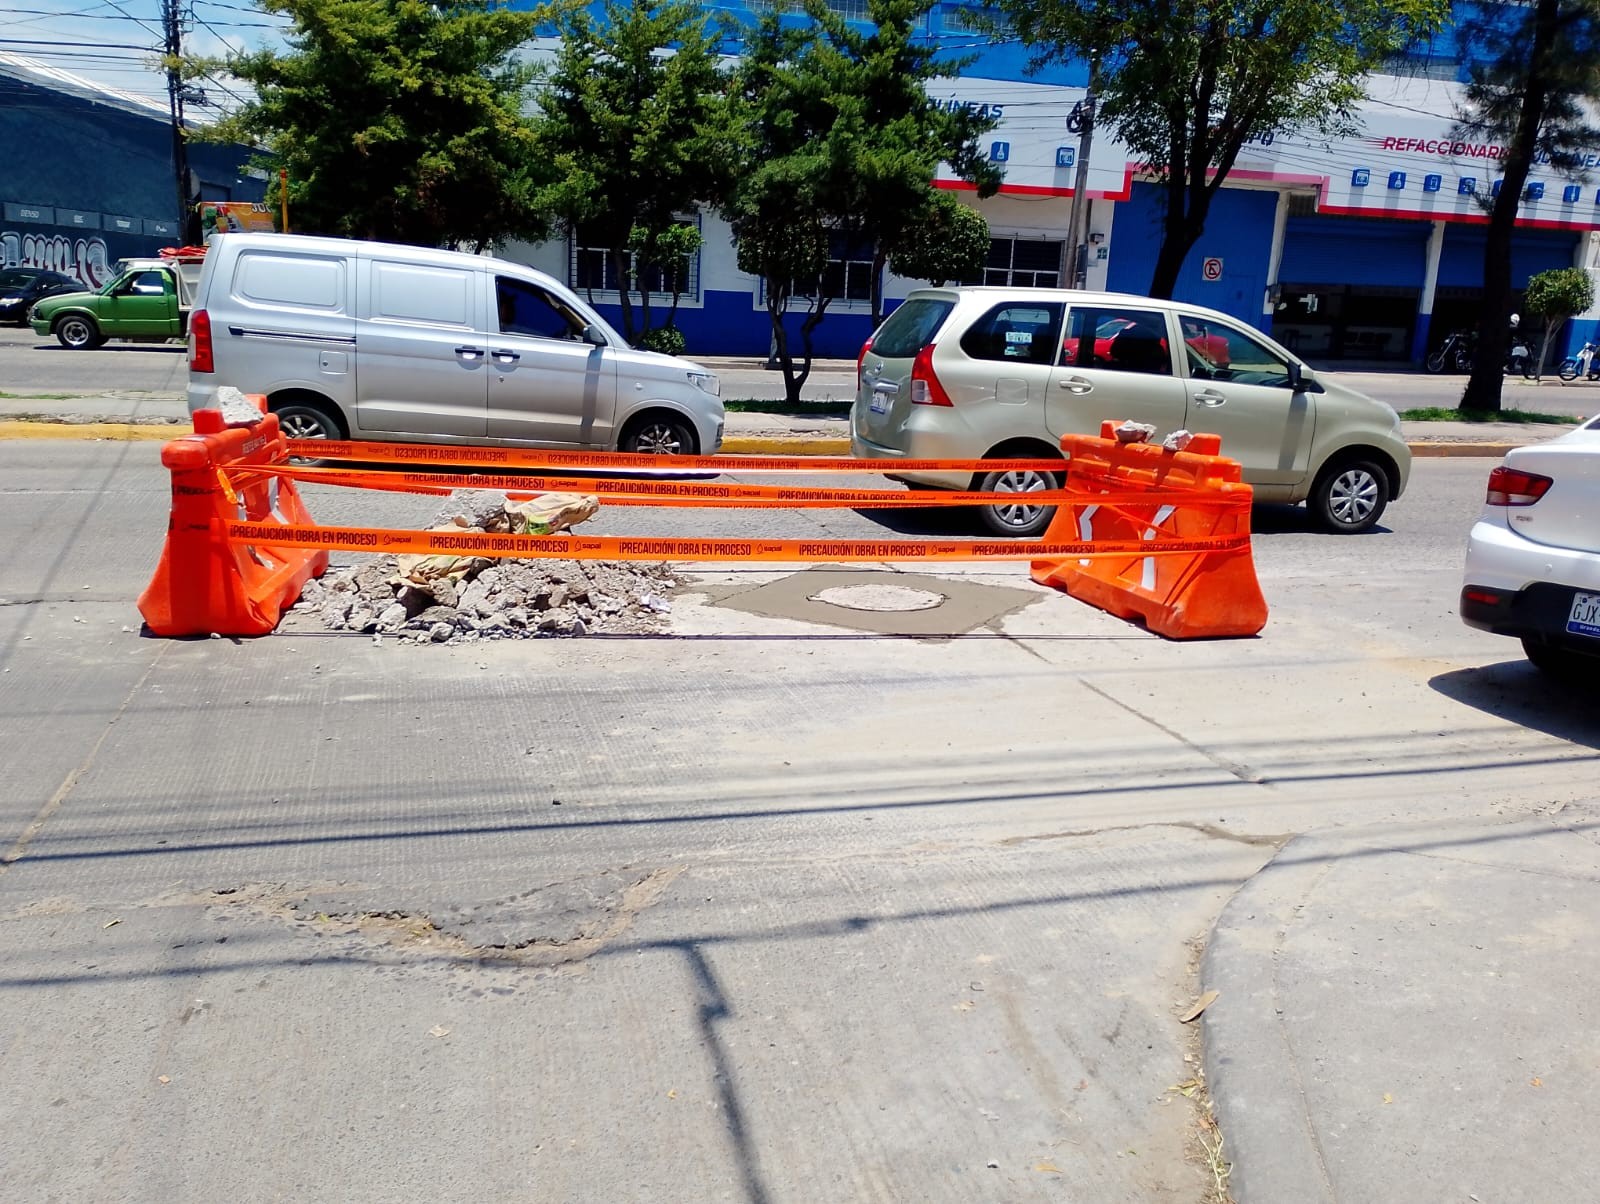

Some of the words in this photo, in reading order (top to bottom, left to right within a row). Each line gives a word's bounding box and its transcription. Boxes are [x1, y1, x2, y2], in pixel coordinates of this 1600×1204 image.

[492, 476, 503, 487] EN
[505, 477, 544, 489] PROCESO
[595, 481, 653, 494] ¡PRECAUCIÓN!
[655, 483, 677, 494] OBRA
[679, 484, 690, 495] EN
[692, 485, 729, 497] PROCESO
[230, 525, 294, 541] ¡PRECAUCIÓN!
[295, 530, 320, 543] OBRA
[322, 532, 334, 543] EN
[336, 532, 377, 546] PROCESO
[430, 537, 490, 550] ¡PRECAUCIÓN!
[491, 539, 515, 551] OBRA
[517, 540, 528, 551] EN
[530, 541, 568, 553] PROCESO
[582, 542, 602, 550] sapal
[619, 542, 675, 555] ¡PRECAUCIÓN!
[677, 543, 700, 555] OBRA
[701, 544, 712, 555] EN
[714, 543, 751, 556] PROCESO
[799, 543, 853, 556] ¡PRECAUCIÓN!
[855, 545, 876, 557] OBRA
[877, 545, 889, 557] EN
[890, 545, 926, 557] PROCESO
[972, 544, 1024, 556] ¡PRECAUCIÓN!
[1048, 545, 1060, 554] EN
[1061, 544, 1095, 554] PROCESO
